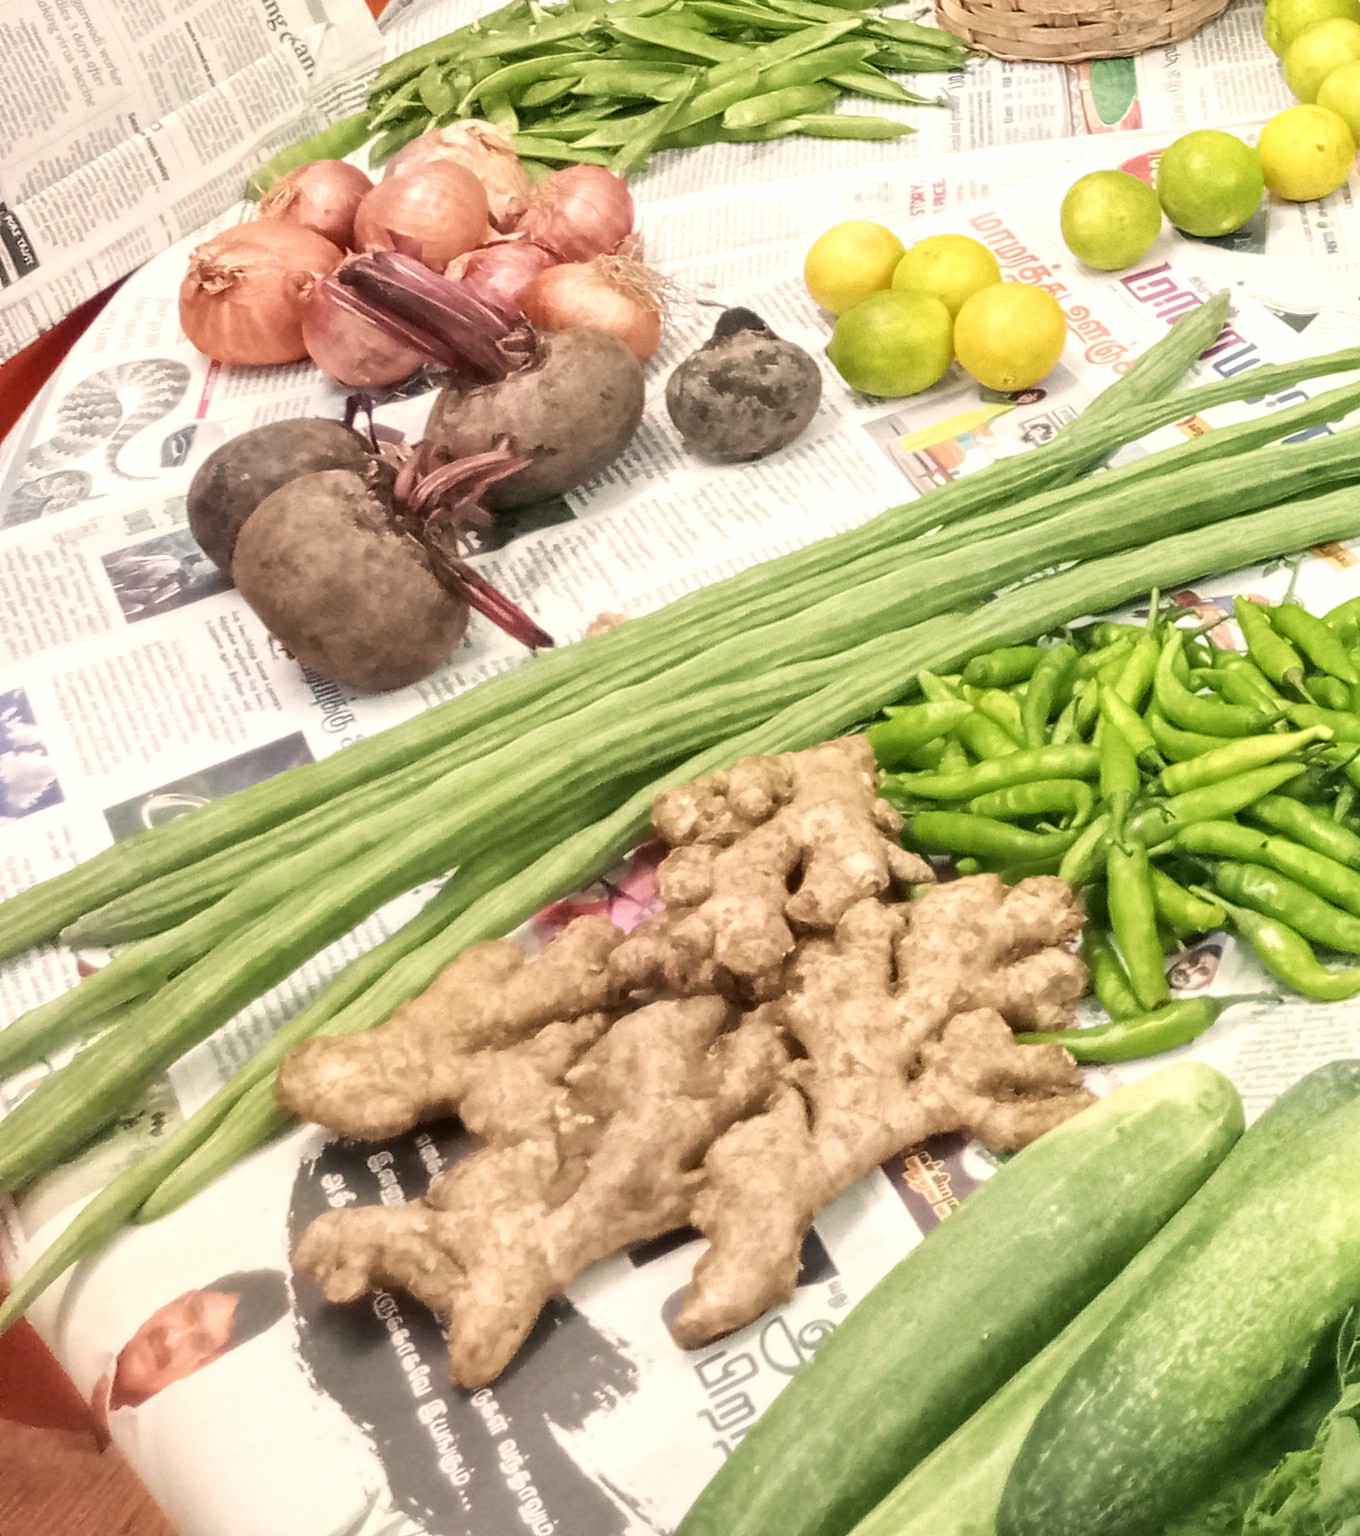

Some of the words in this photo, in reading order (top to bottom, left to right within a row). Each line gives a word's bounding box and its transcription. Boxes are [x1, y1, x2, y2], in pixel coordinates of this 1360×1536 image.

[54, 32, 76, 64] virus
[67, 64, 99, 108] vaccine
[68, 30, 93, 61] days
[84, 59, 107, 89] after
[96, 47, 125, 88] worker
